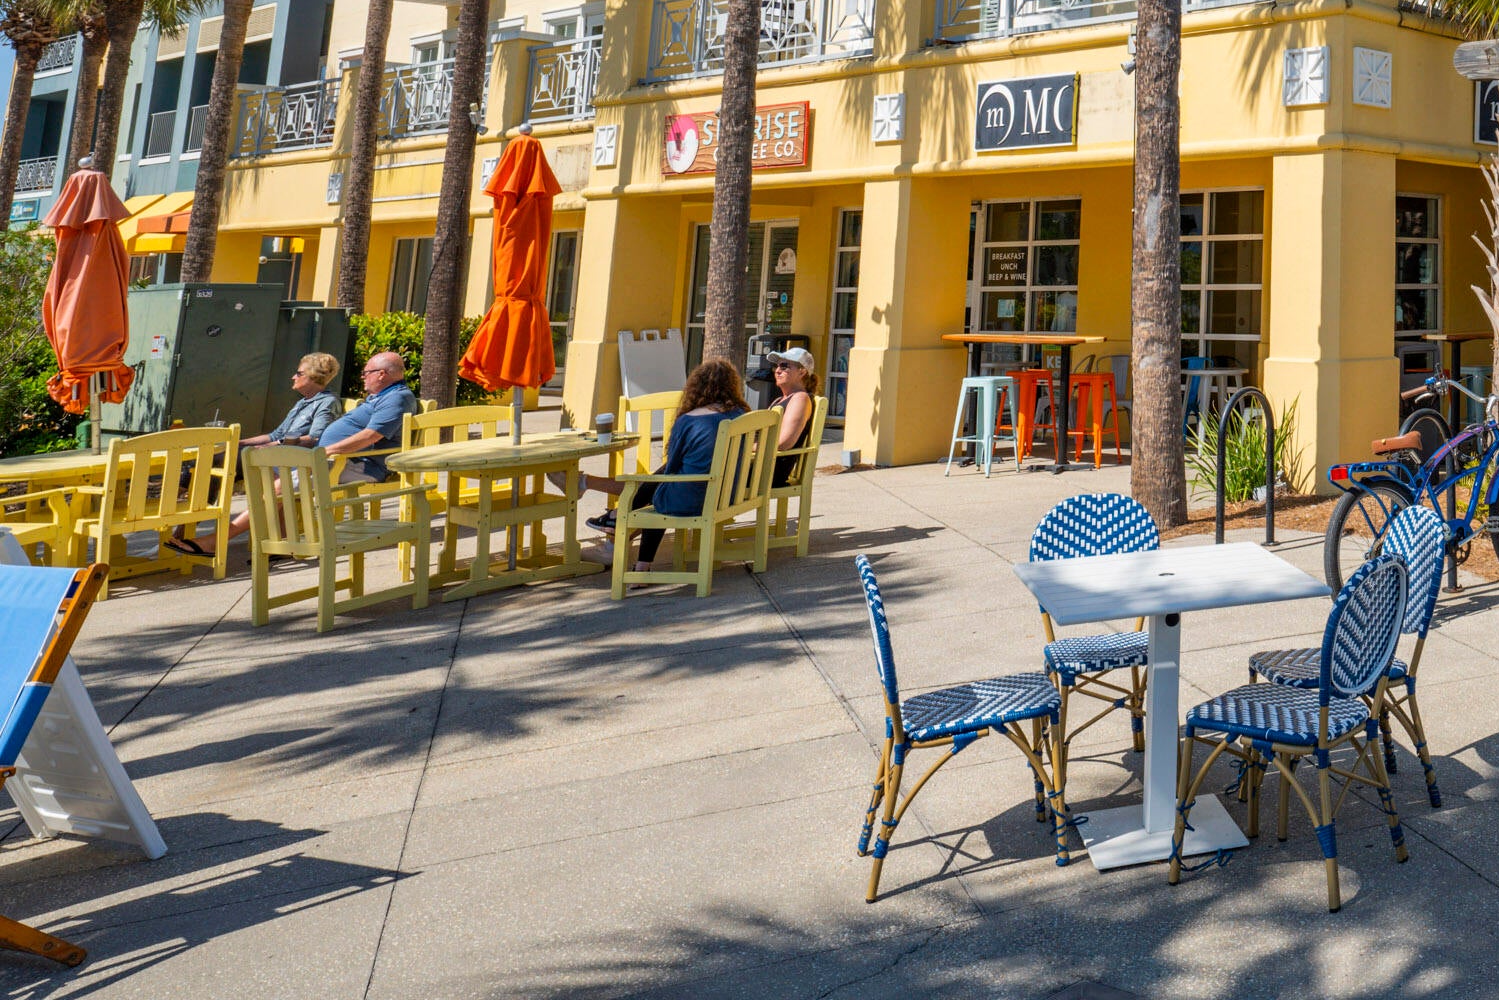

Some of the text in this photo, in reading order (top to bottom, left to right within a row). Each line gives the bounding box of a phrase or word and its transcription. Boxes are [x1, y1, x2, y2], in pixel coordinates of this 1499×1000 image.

[702, 110, 800, 146] SRISE
[991, 252, 1025, 261] BREAKFAST
[1010, 272, 1027, 281] WINE
